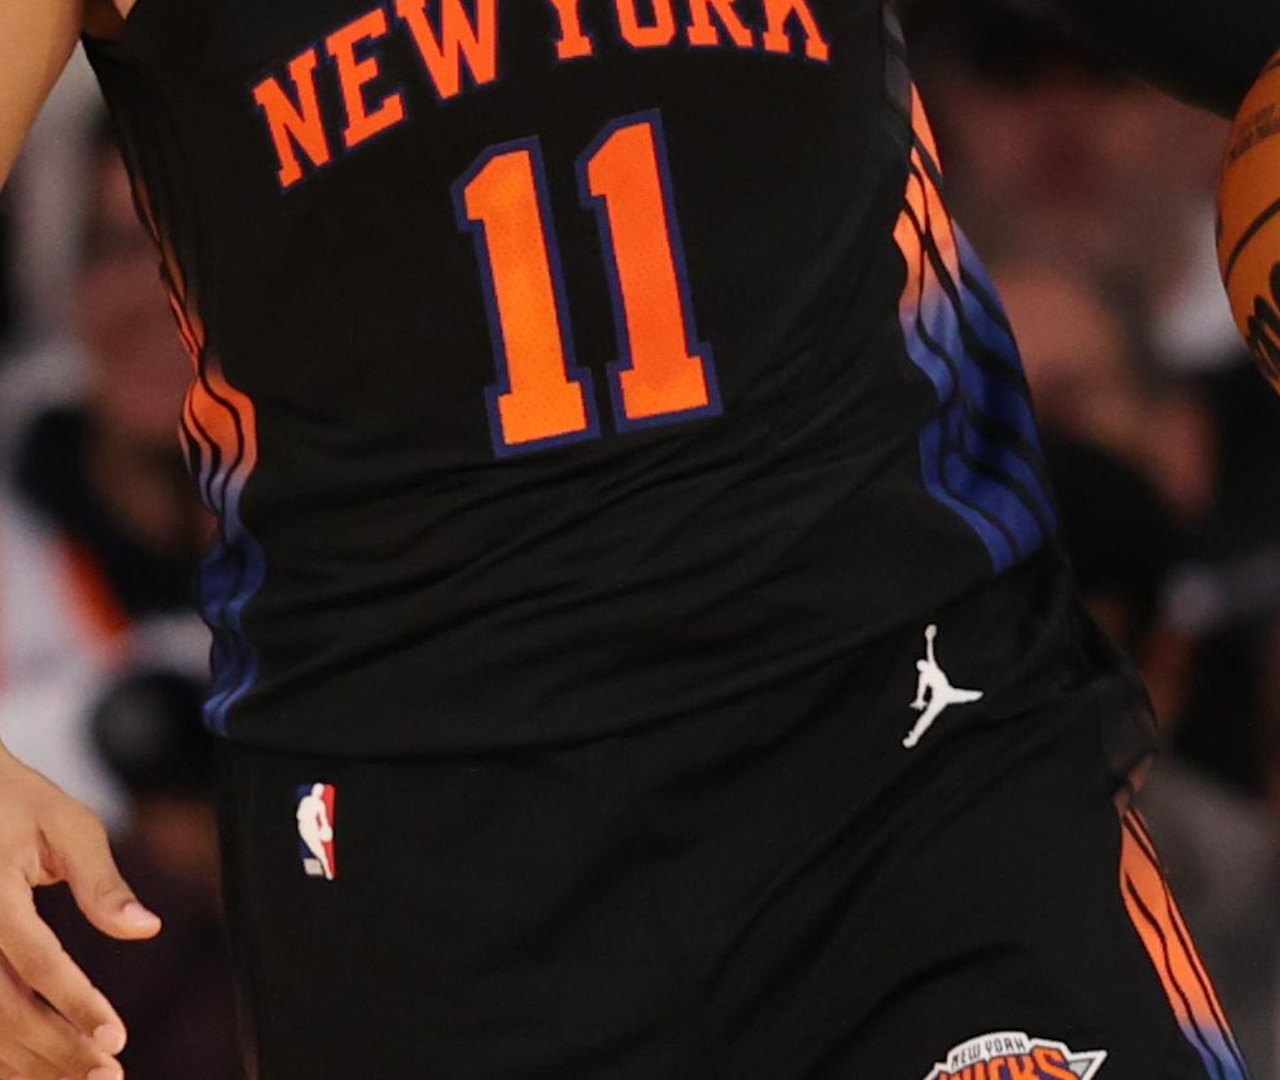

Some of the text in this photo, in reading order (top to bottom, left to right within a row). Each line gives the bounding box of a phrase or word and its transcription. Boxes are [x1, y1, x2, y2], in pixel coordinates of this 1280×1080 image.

[450, 108, 723, 457] 11
[950, 1036, 1026, 1068] NEW YORK
